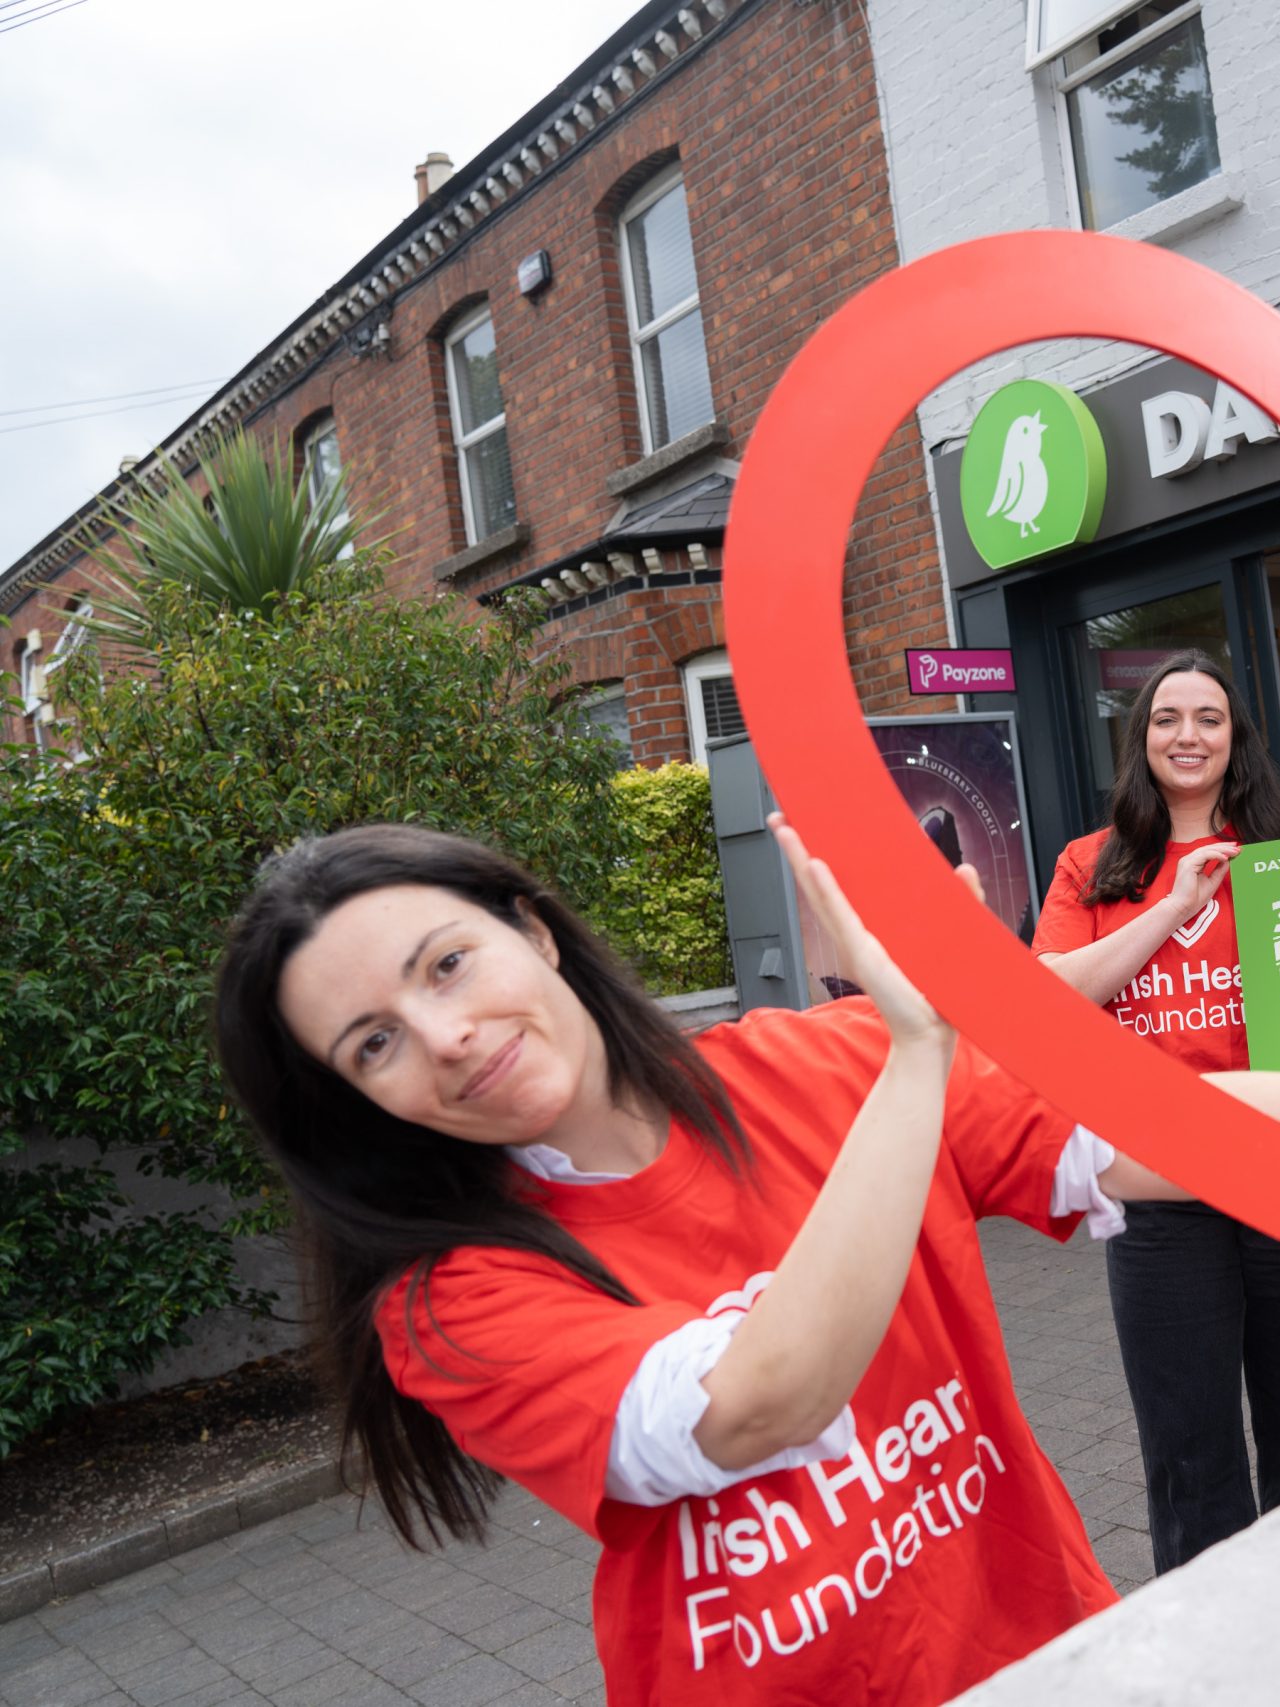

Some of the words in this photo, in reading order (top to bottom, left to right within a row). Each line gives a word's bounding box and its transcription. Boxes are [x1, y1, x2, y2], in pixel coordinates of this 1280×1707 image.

[942, 664, 1006, 685] Payzone
[918, 757, 971, 793] BLUEBERRY
[971, 794, 998, 836] COOKIE
[1113, 963, 1174, 1003] ish
[1182, 960, 1243, 994] Hea
[1116, 992, 1247, 1036] Foundati
[678, 1486, 812, 1580] Irish
[806, 1370, 970, 1528] Hear
[686, 1433, 1006, 1671] Foundation
